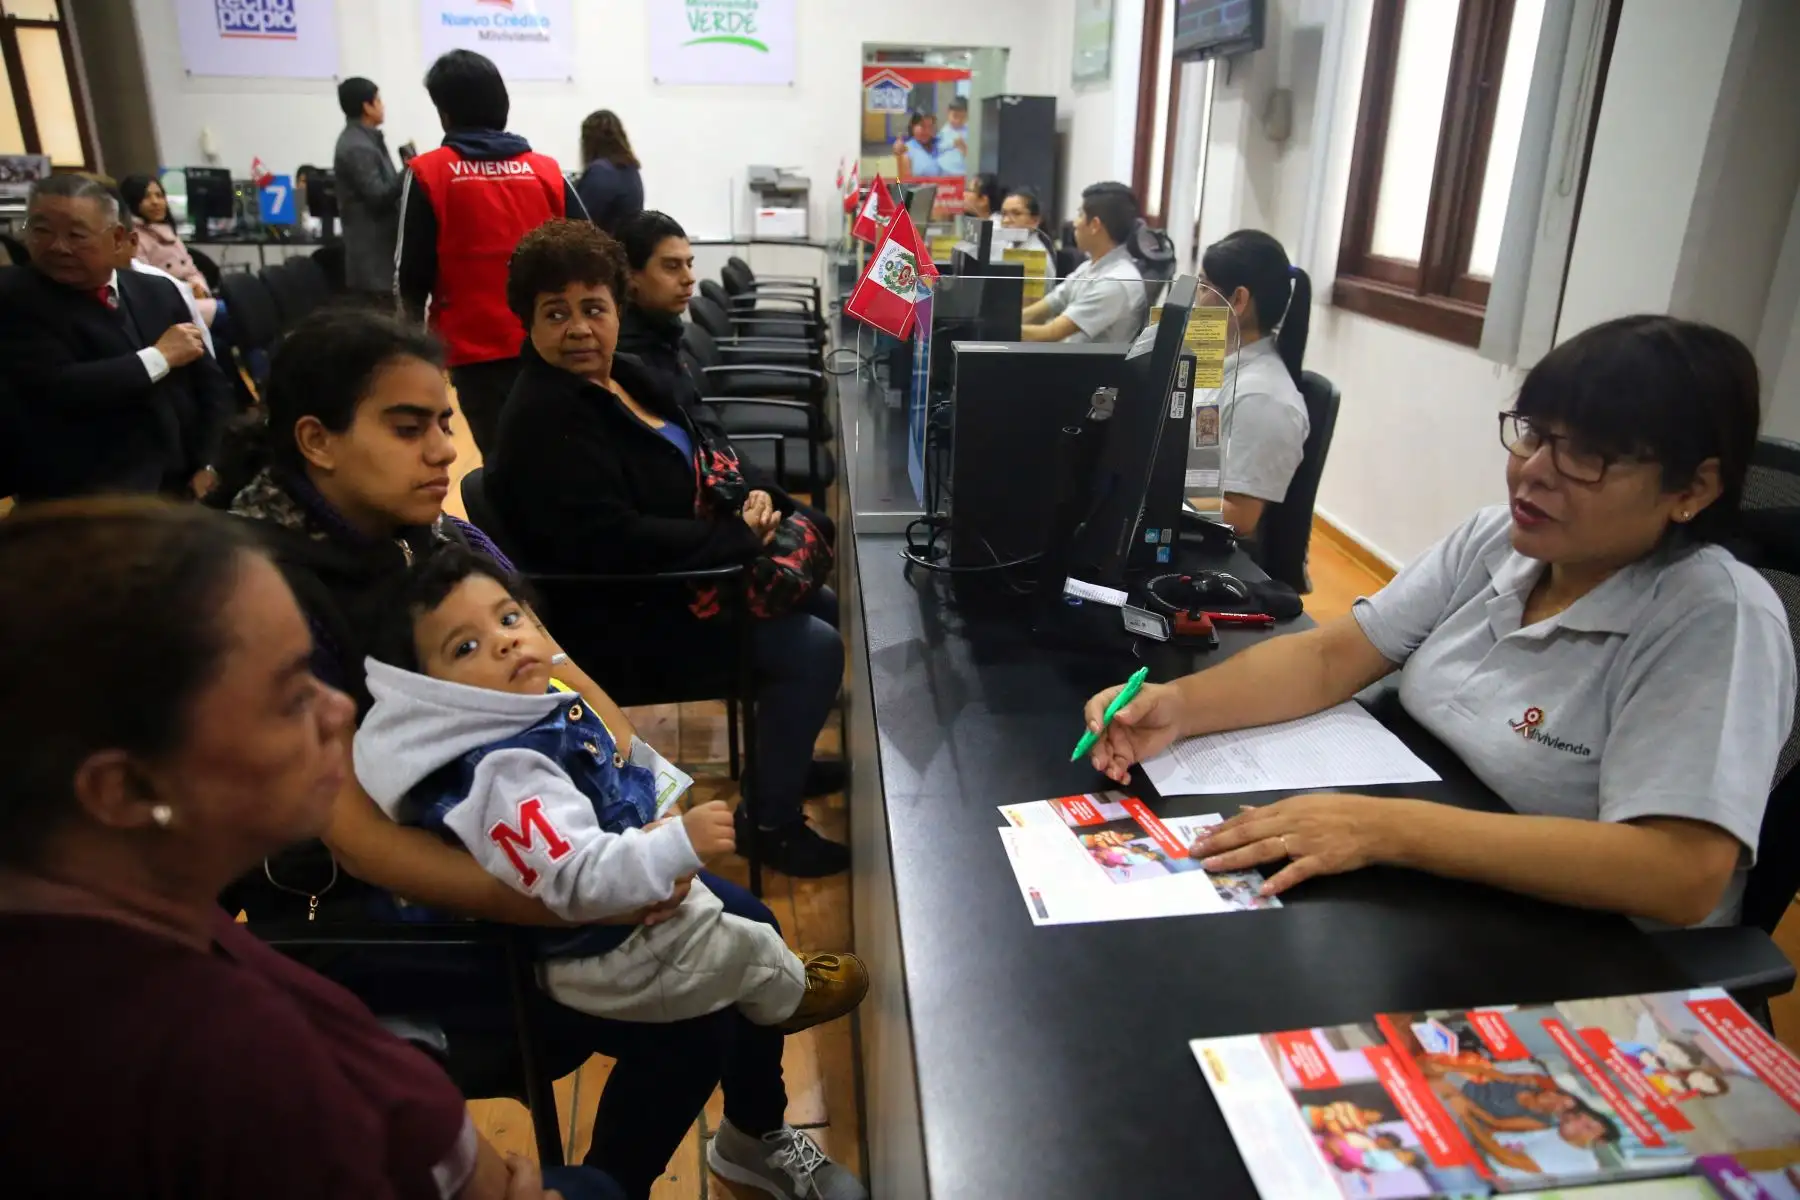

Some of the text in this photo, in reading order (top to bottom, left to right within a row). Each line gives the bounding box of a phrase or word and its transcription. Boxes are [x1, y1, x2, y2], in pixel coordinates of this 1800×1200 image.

[219, 10, 296, 33] propio
[441, 12, 489, 26] Nuevo
[687, 10, 757, 33] VERDE
[448, 161, 534, 175] VIVIENDA
[265, 186, 287, 215] 7
[488, 795, 576, 890] M
